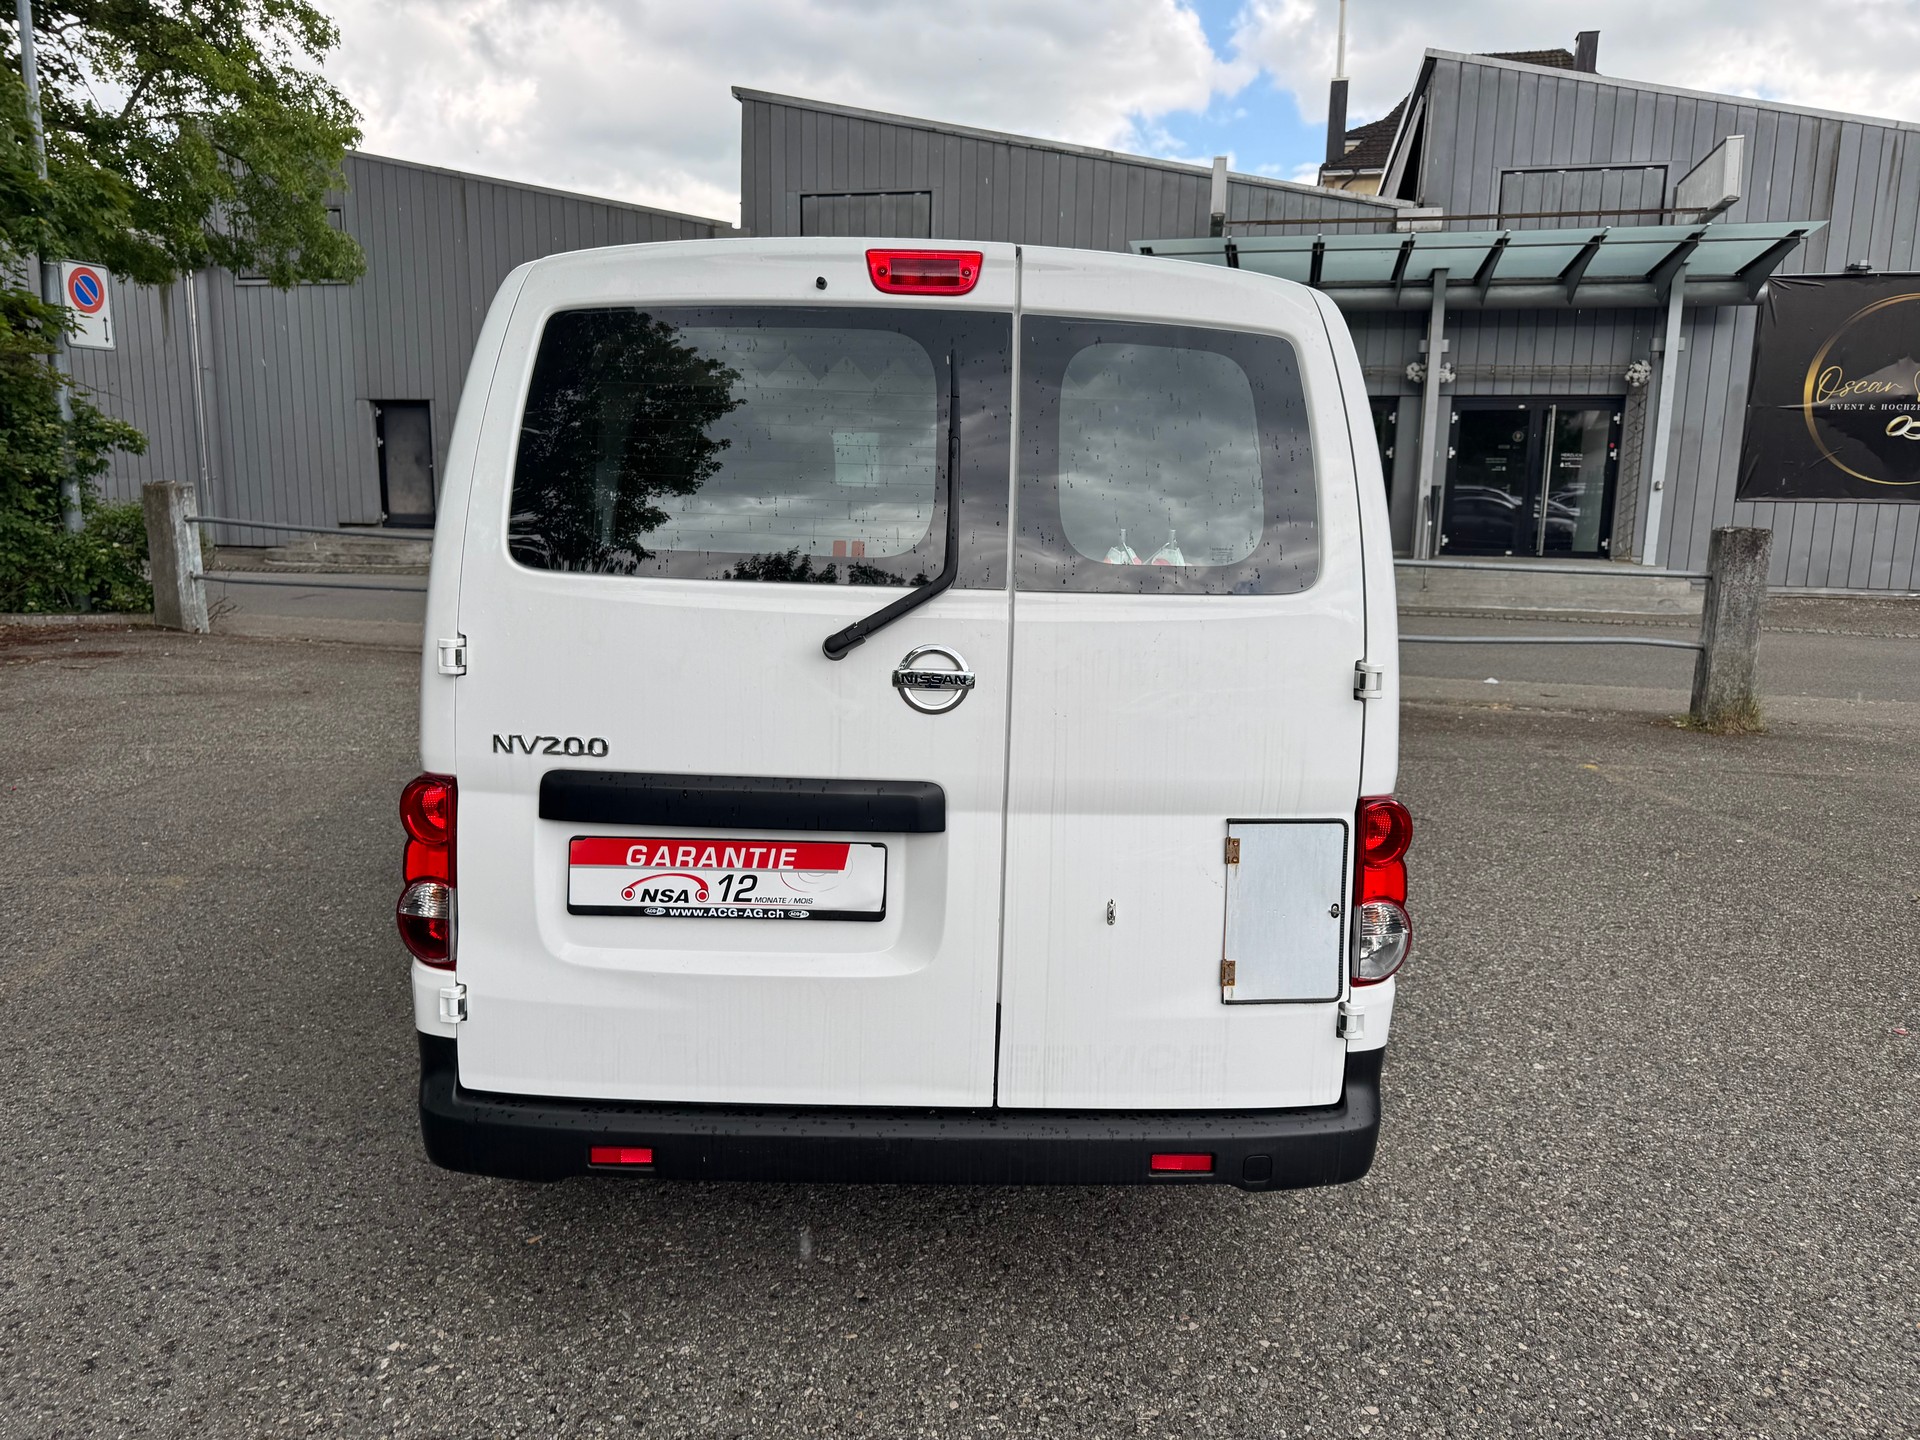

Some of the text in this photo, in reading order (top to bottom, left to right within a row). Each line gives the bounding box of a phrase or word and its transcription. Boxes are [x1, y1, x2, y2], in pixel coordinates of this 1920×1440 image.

[1816, 365, 1903, 403] Oscar
[1829, 403, 1864, 411] EVENT
[1869, 403, 1876, 411] &
[900, 673, 967, 686] NISSAN
[492, 734, 610, 757] NV200
[626, 844, 798, 870] GARANTIE
[640, 888, 690, 904] NSA
[718, 873, 759, 903] 12
[754, 896, 787, 904] MONATE
[793, 897, 814, 905] MOIS
[669, 908, 785, 919] www.ACG-AG.ch
